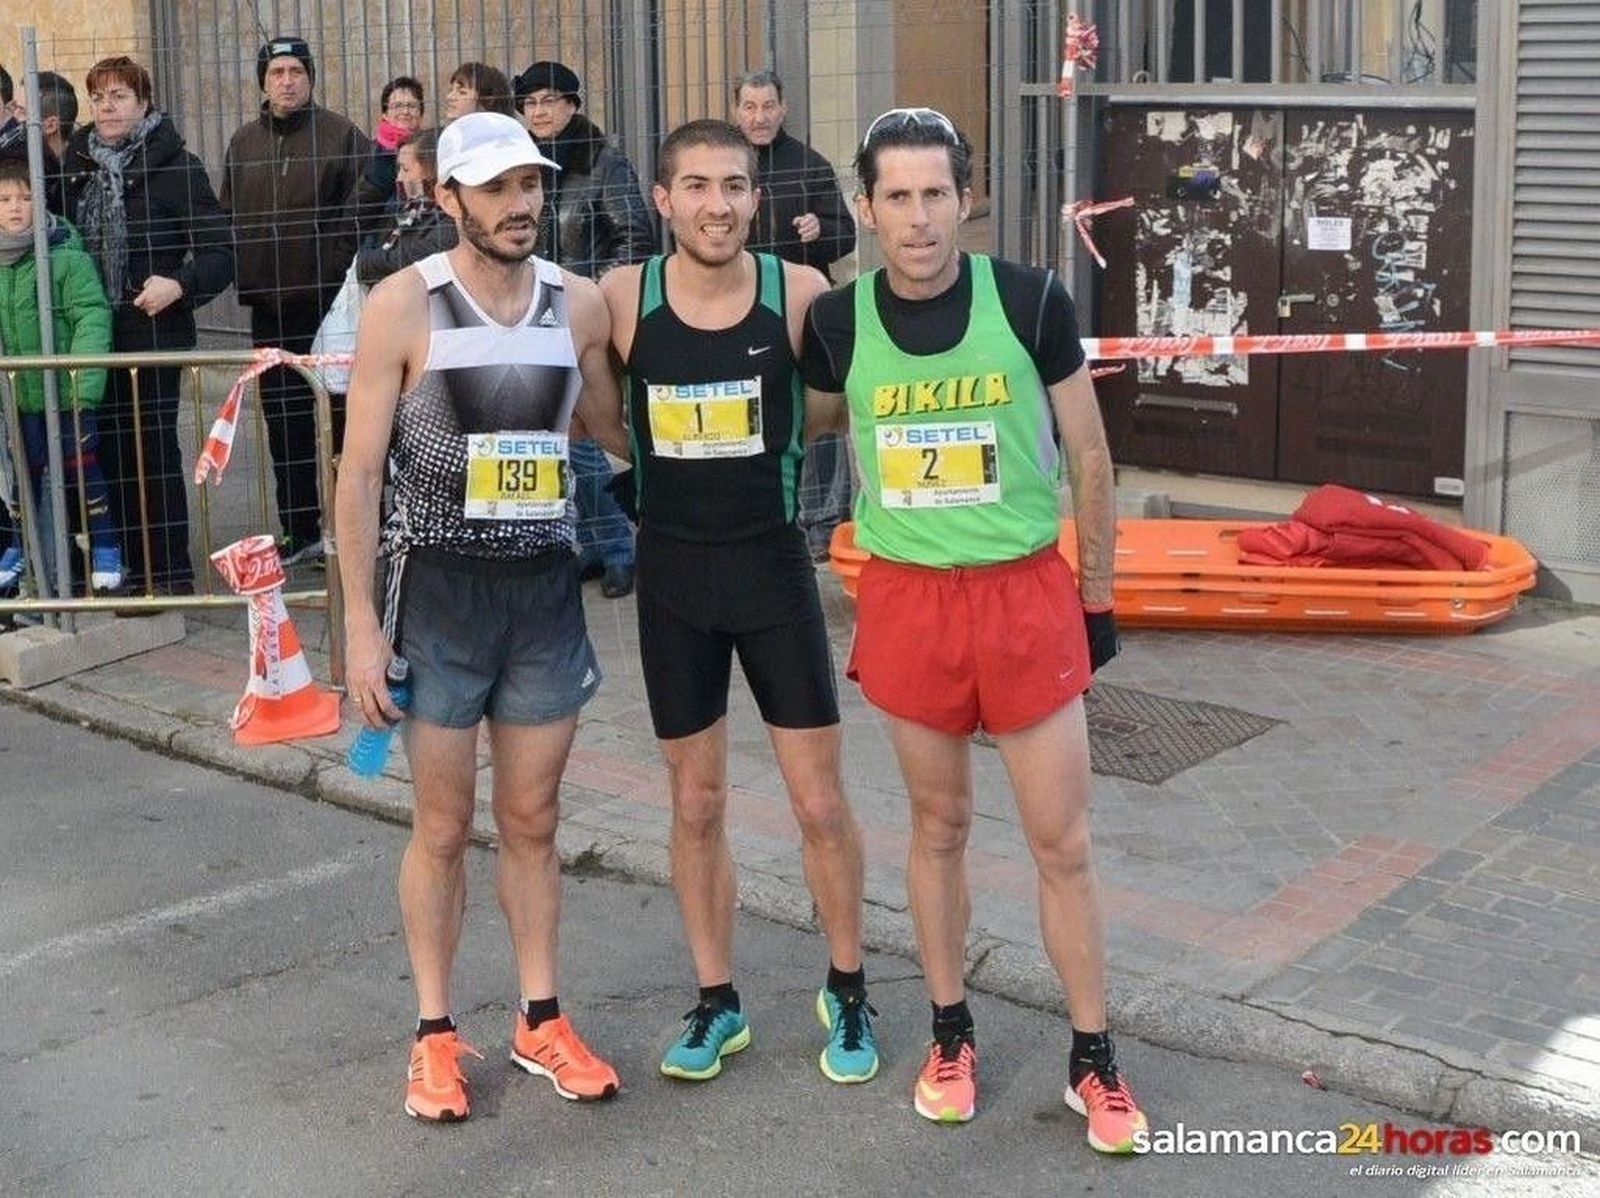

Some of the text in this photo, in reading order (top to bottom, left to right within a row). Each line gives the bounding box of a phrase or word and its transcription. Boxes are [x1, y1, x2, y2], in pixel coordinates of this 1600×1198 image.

[676, 382, 752, 398] SETEL
[874, 373, 1013, 419] BIKILA
[695, 403, 703, 433] 1
[498, 440, 562, 454] SETEL
[906, 427, 988, 443] SETEL
[497, 460, 537, 491] 139
[922, 448, 939, 480] 2
